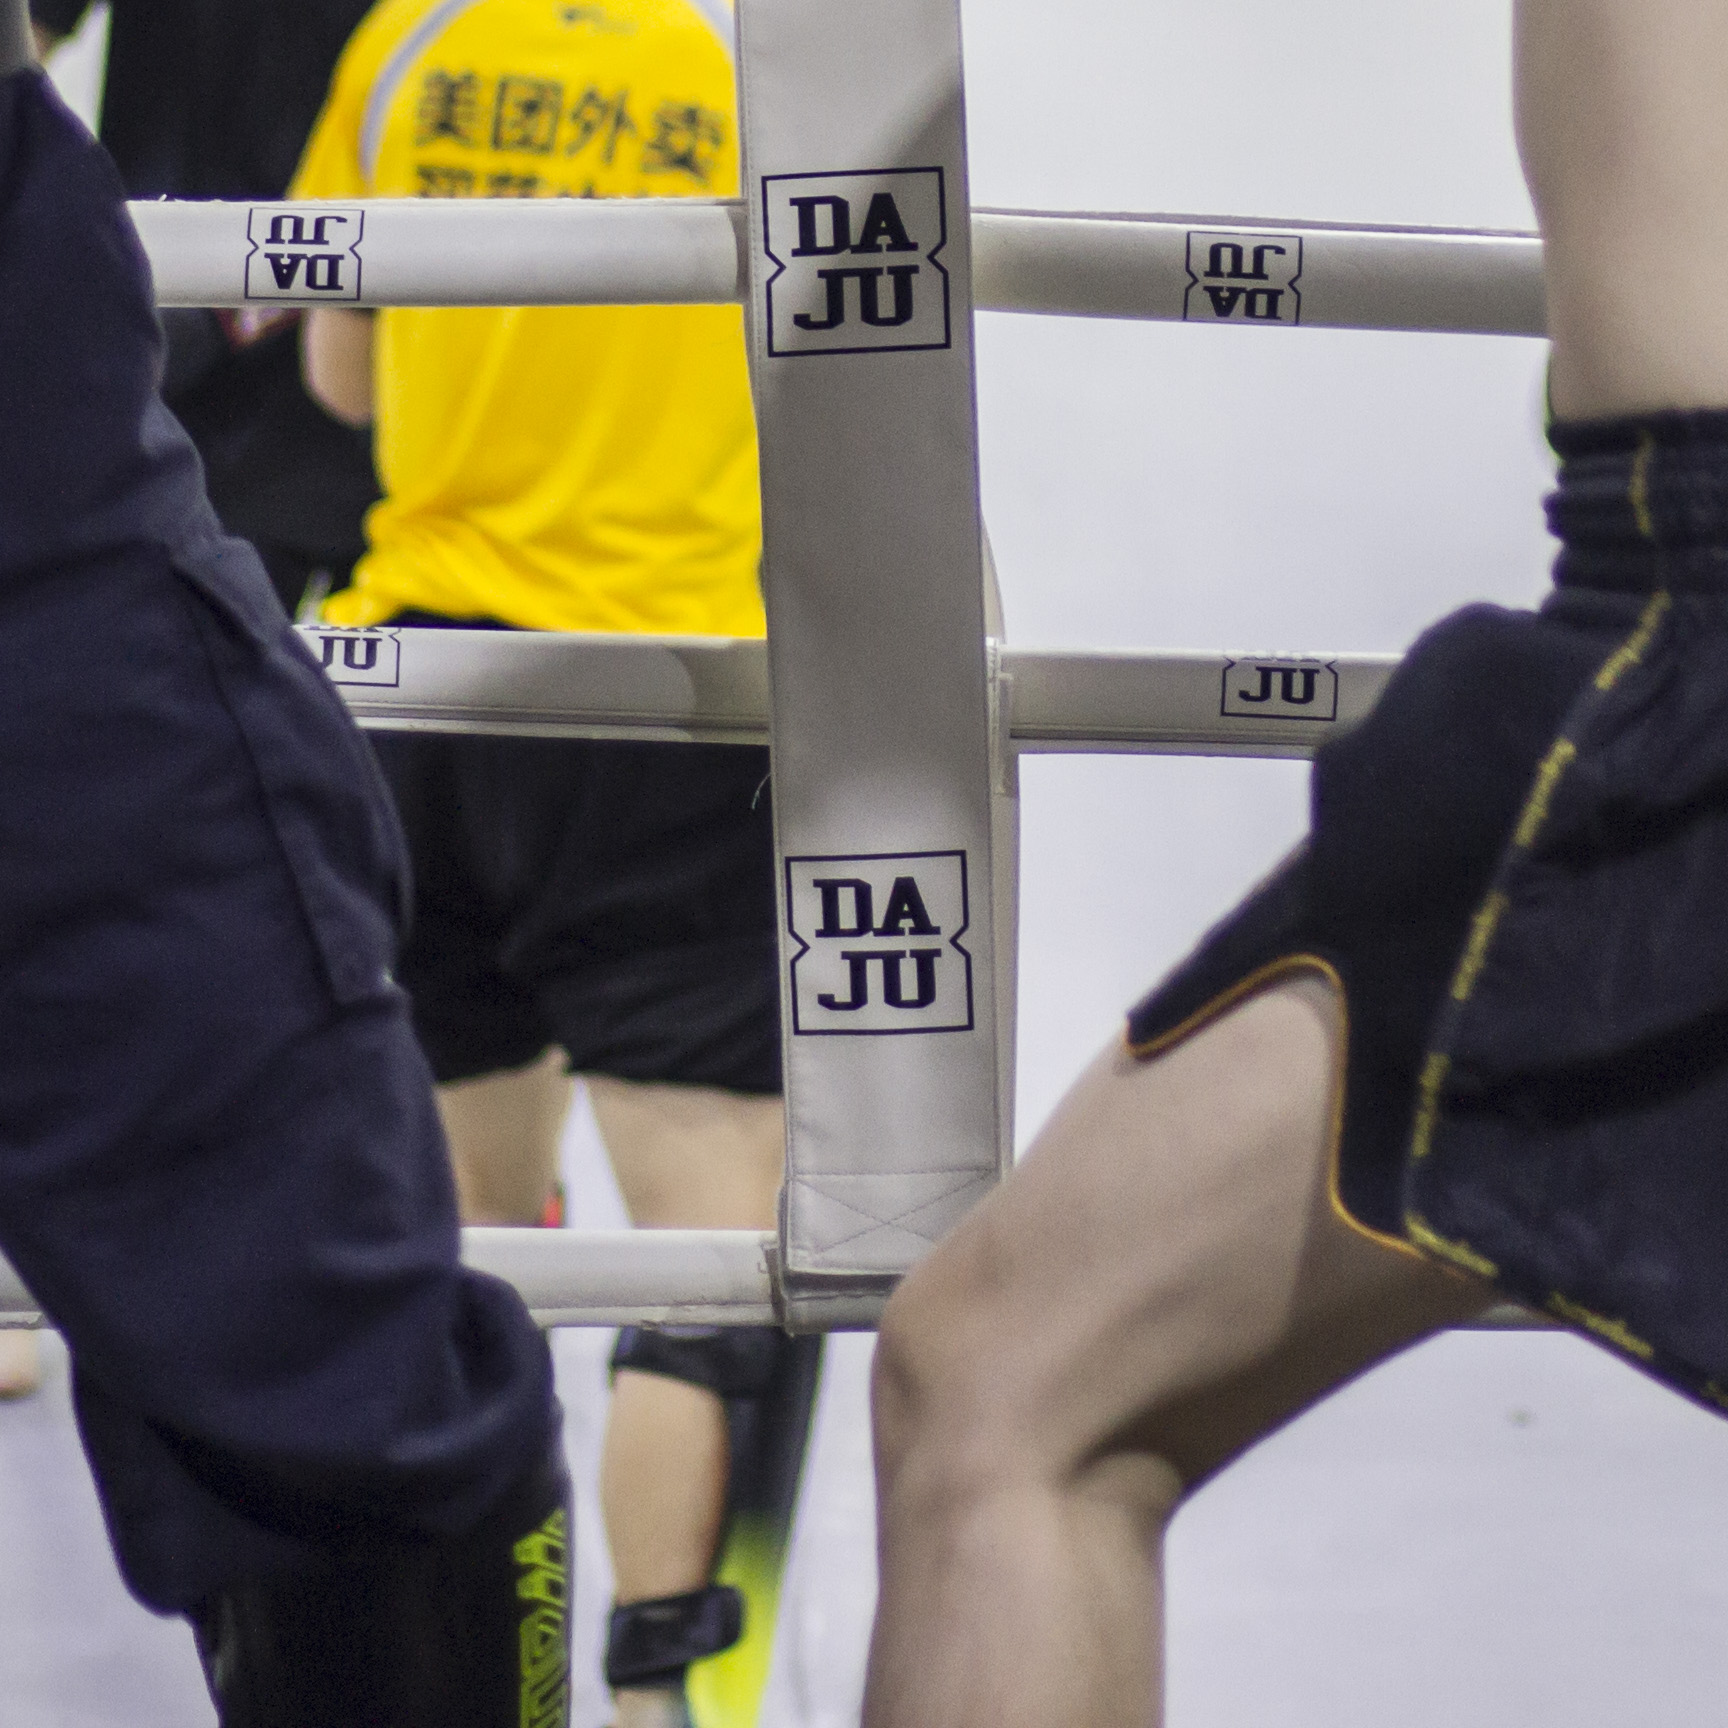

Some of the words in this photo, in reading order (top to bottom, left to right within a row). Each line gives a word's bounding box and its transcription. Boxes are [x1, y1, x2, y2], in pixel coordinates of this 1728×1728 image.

[413, 68, 728, 188] 美团外卖
[265, 215, 348, 245] JU
[789, 193, 918, 257] DA
[264, 253, 345, 290] DA
[1204, 242, 1286, 280] JU
[793, 265, 920, 330] JU
[1203, 286, 1284, 320] DA
[319, 636, 382, 670] JU
[1238, 666, 1320, 704] JU
[812, 876, 941, 938] DA
[817, 948, 942, 1011] JU
